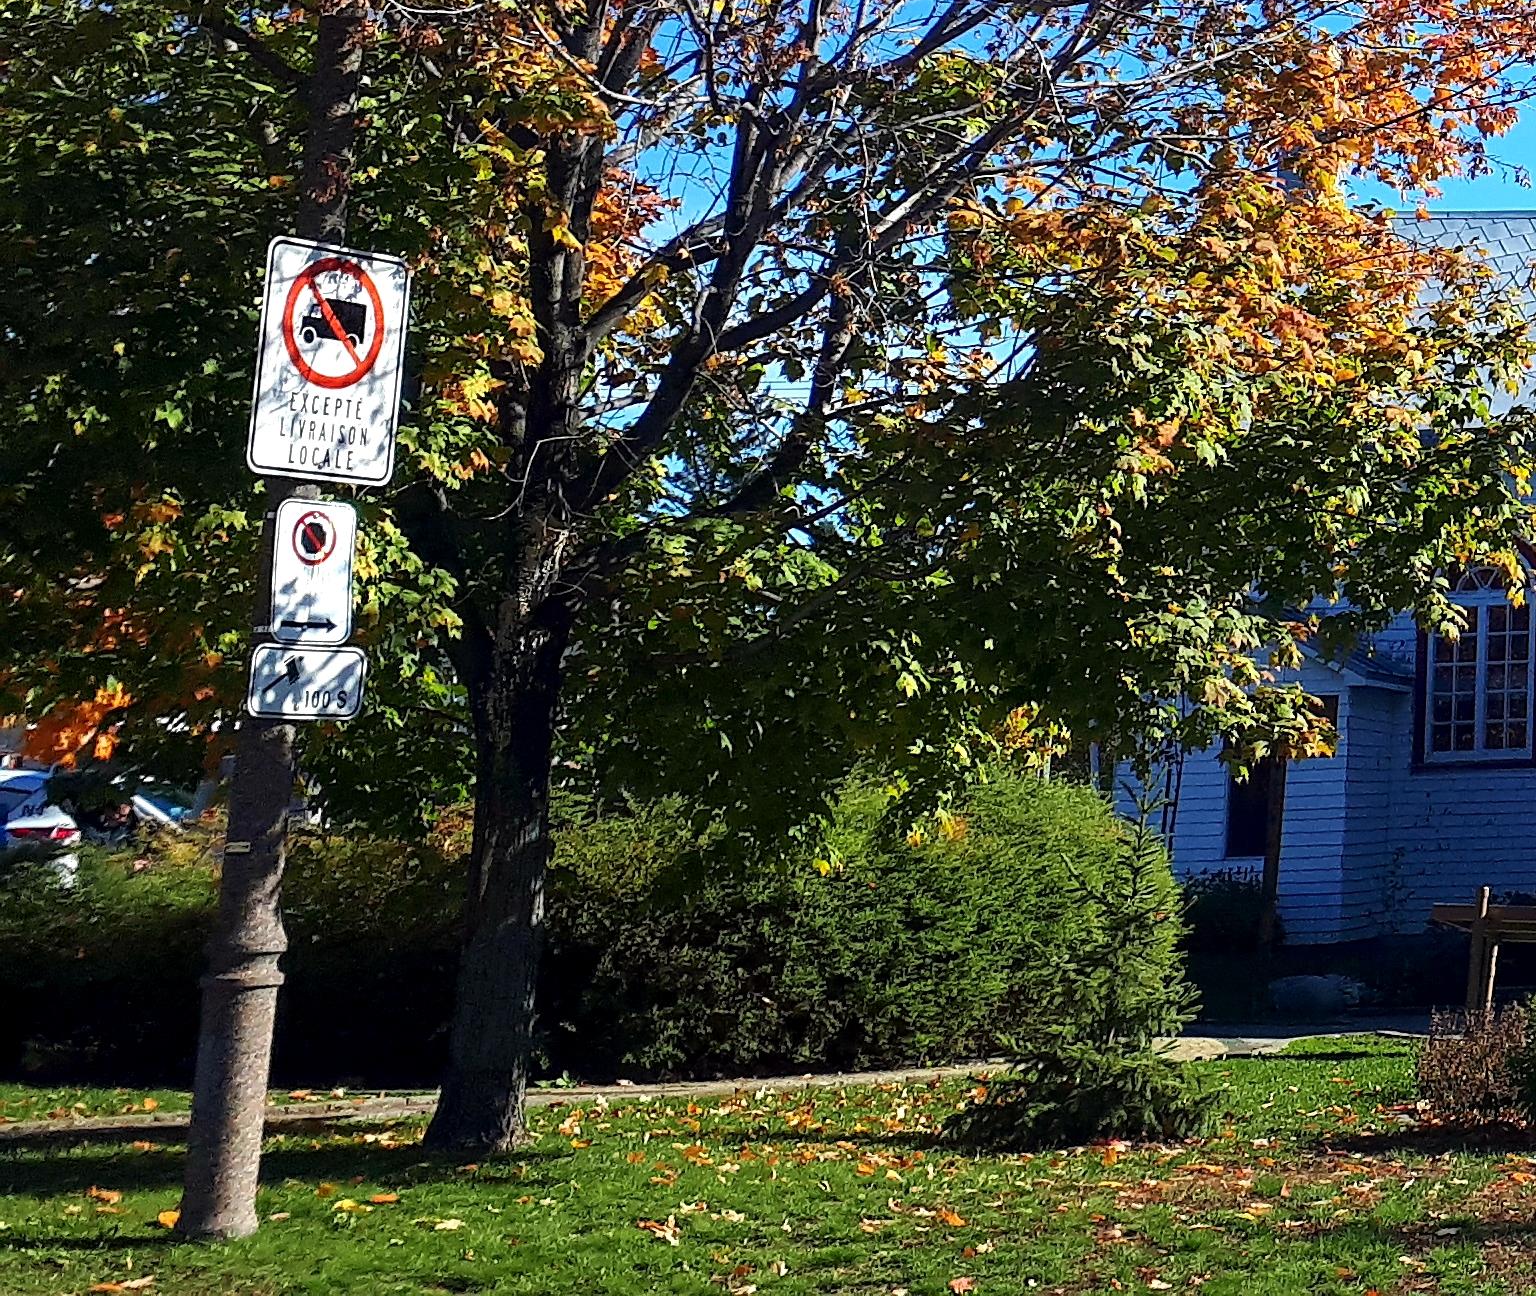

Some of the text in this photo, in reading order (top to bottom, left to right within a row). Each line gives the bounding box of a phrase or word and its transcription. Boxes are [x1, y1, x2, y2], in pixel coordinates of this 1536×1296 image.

[290, 391, 363, 420] EXCEPTÉ
[280, 416, 368, 446] LIVRAISON
[288, 444, 354, 471] LOCALE
[305, 690, 330, 708] 100
